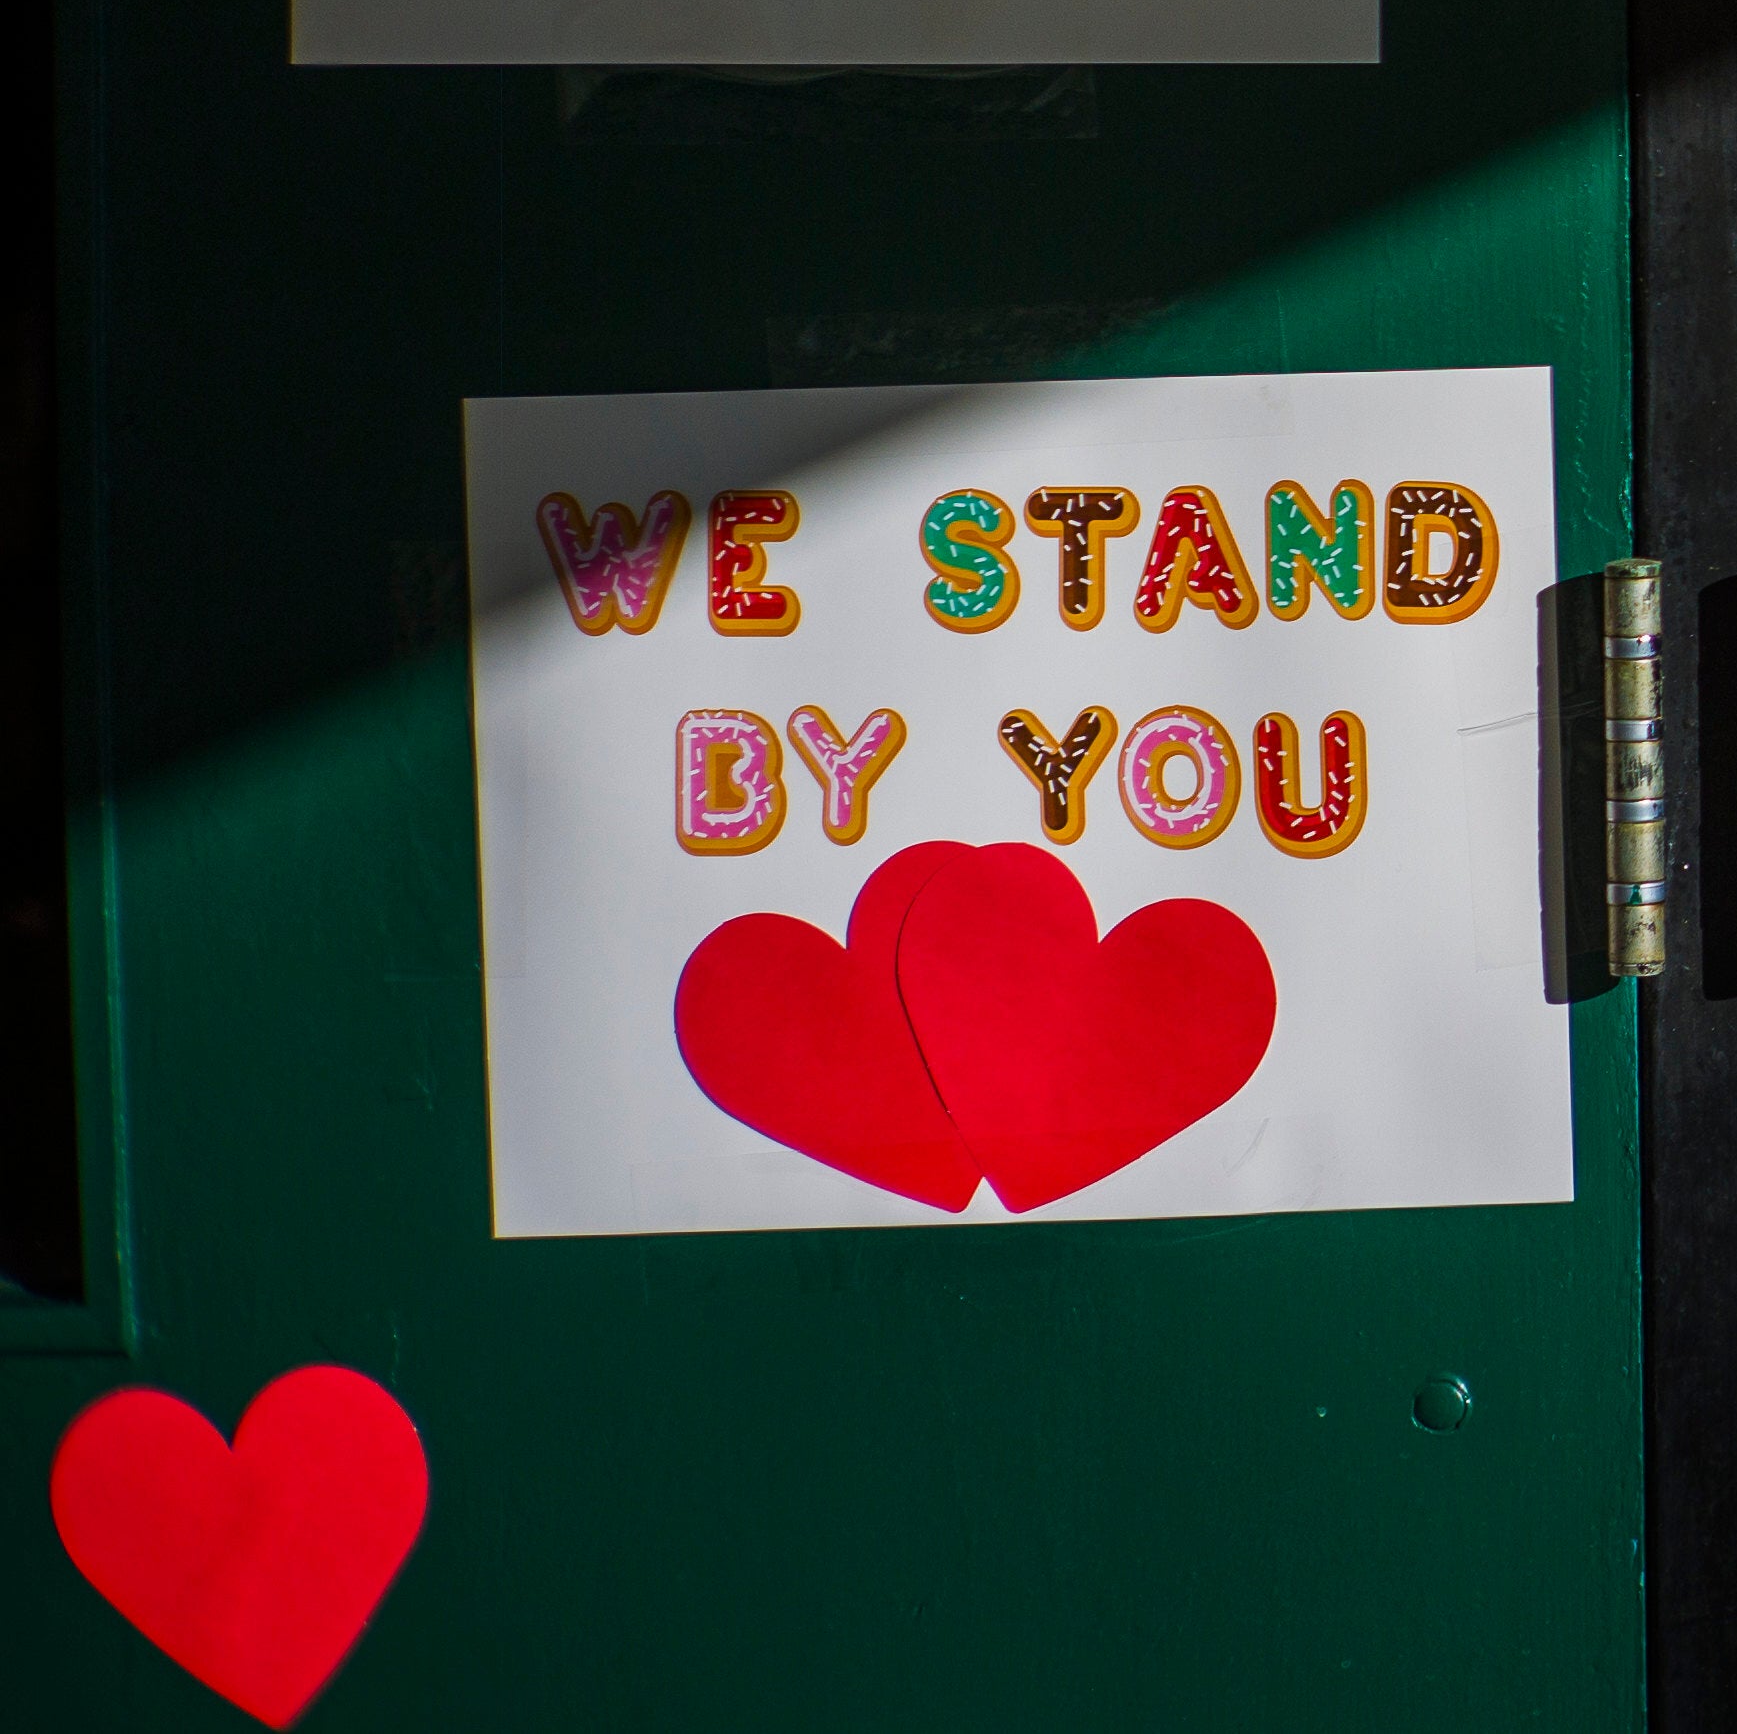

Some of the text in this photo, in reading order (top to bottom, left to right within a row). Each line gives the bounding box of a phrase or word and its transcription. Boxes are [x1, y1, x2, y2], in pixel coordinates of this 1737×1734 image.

[536, 479, 1500, 637] WE STAND
[675, 705, 1368, 859] BY YOU
